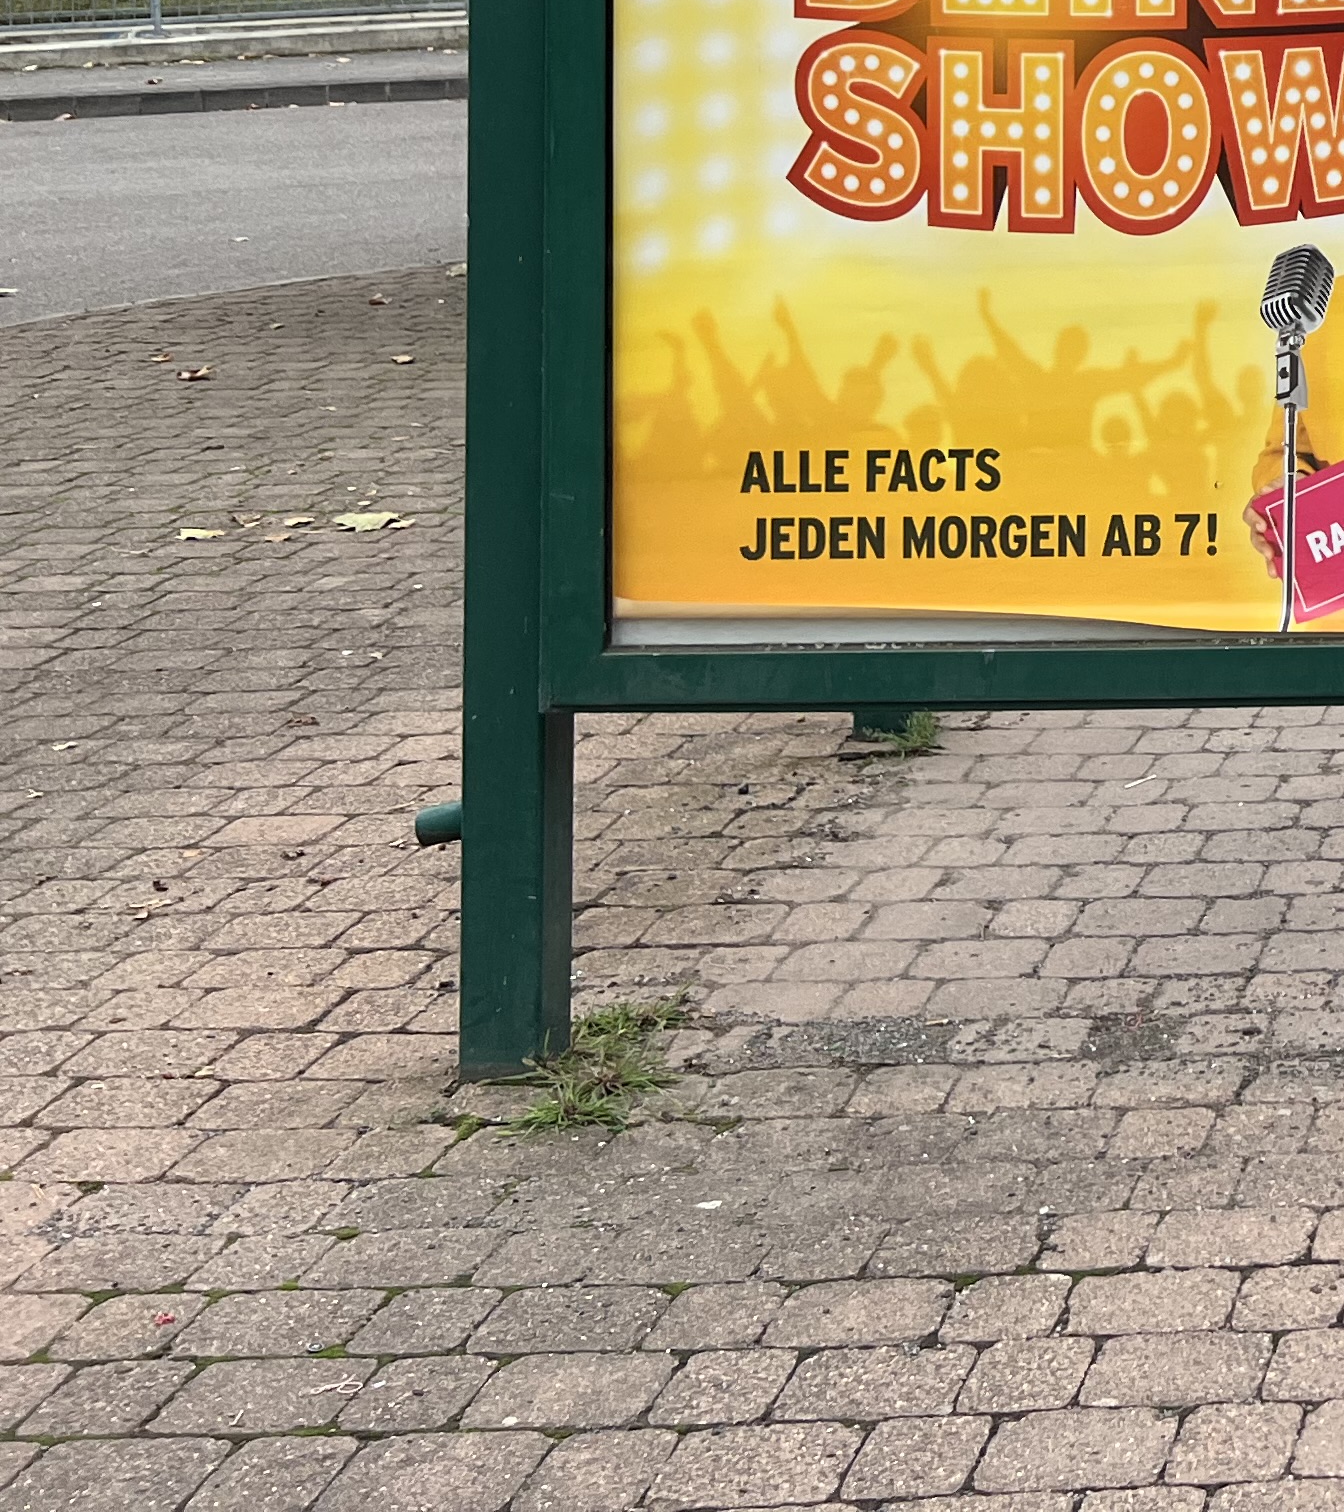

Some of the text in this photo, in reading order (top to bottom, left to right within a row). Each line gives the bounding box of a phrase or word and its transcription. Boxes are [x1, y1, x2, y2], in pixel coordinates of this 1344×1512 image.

[740, 447, 1002, 494] ALLE FACTS
[739, 511, 1219, 561] JEDEN MORGEN AB 7!
